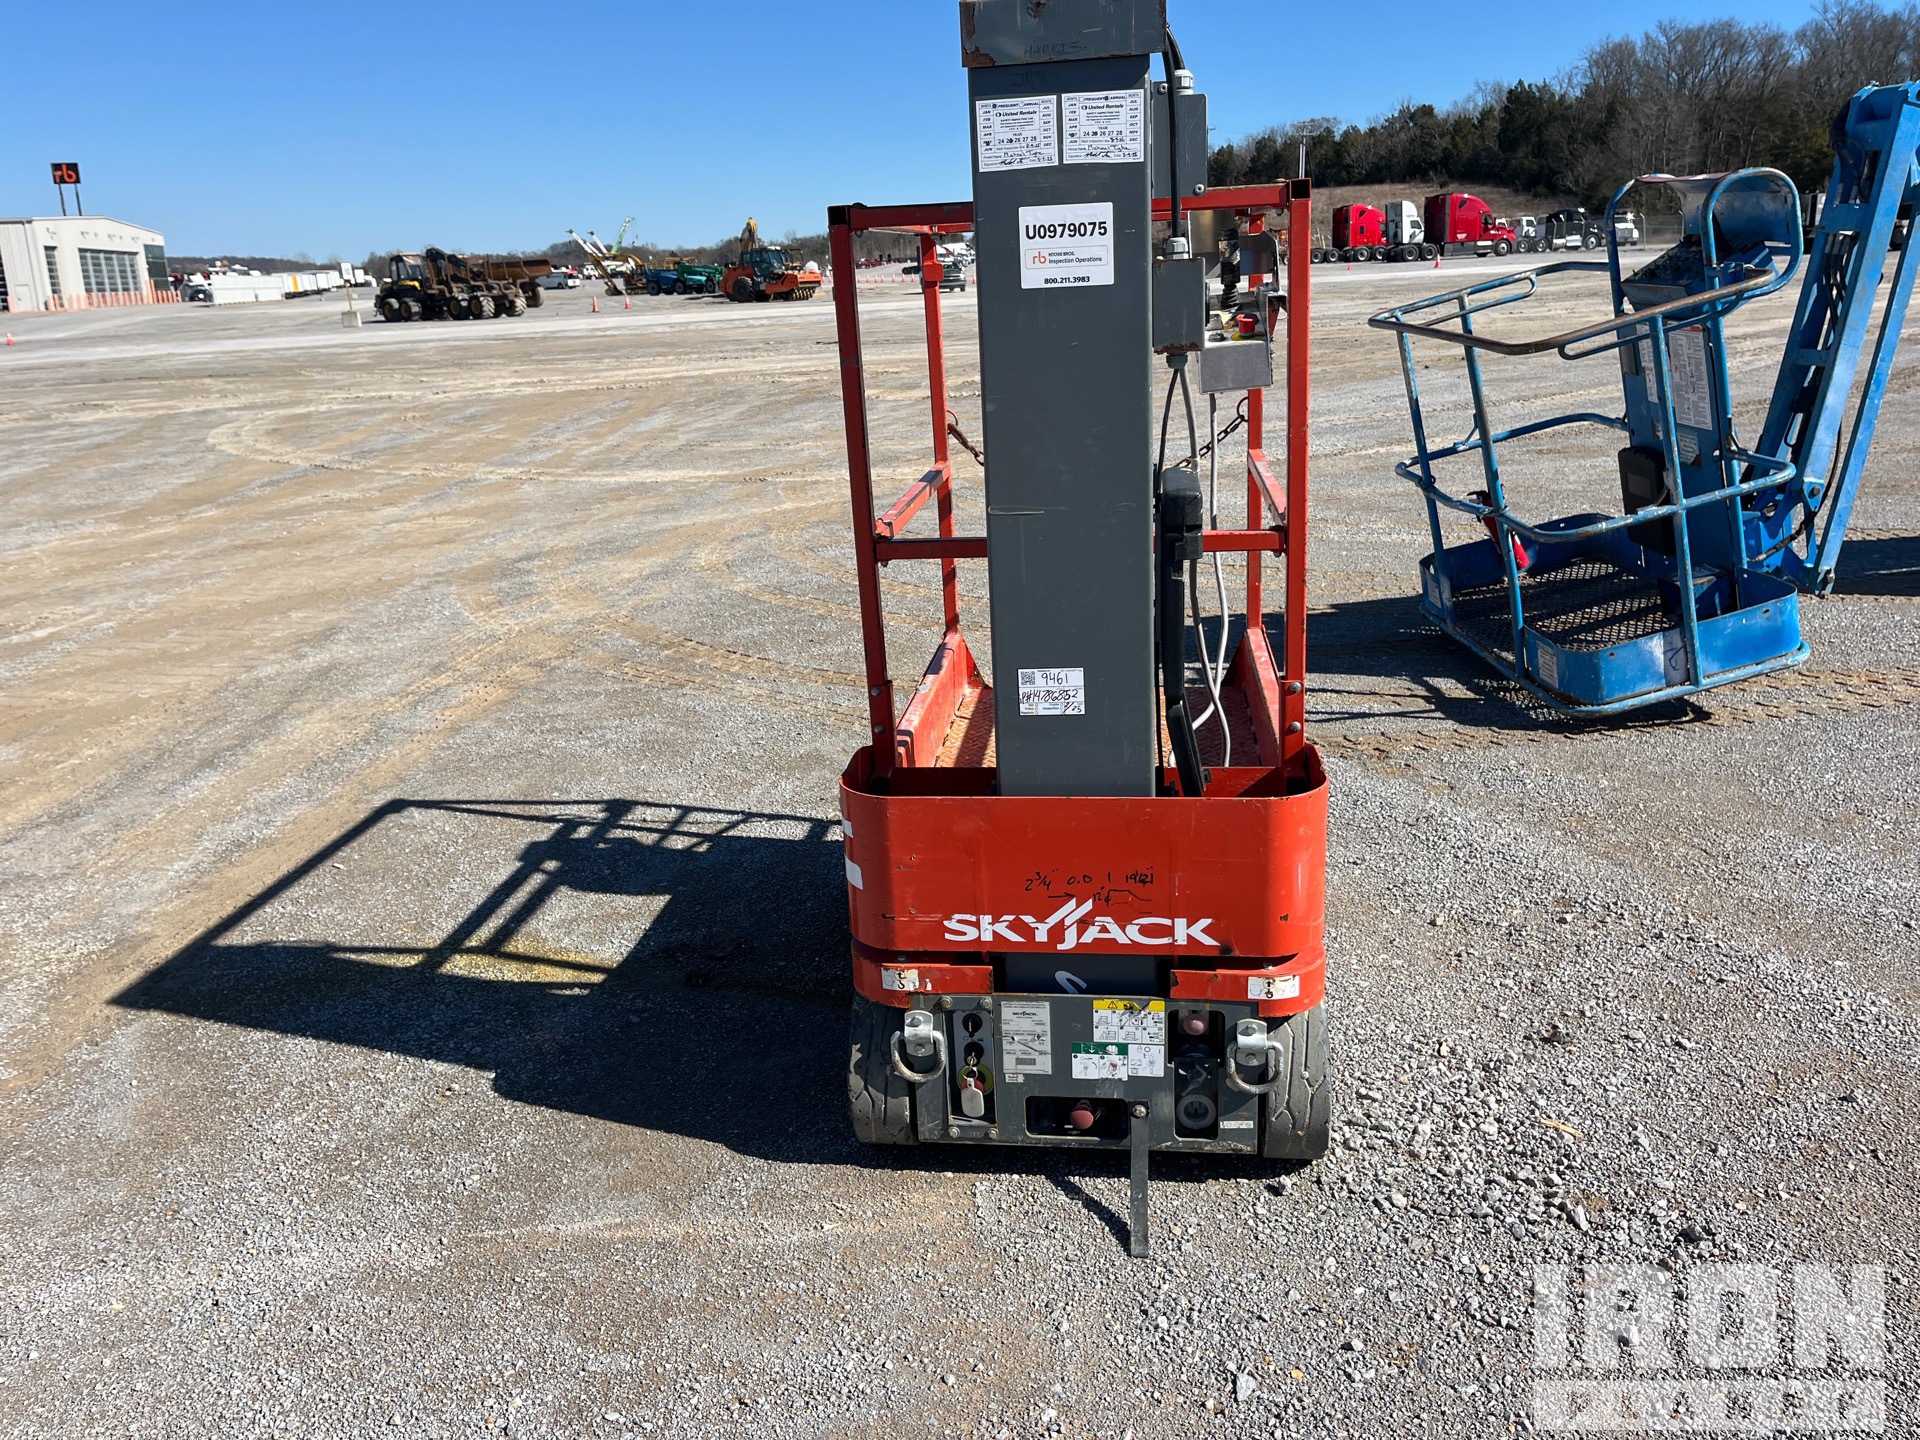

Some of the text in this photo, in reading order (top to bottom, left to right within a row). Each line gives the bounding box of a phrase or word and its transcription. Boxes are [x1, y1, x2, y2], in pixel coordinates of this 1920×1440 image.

[1026, 221, 1107, 239] U0979075
[1033, 251, 1046, 264] rb
[1044, 276, 1090, 284] 800.211.3983
[1041, 672, 1068, 685] 9461
[943, 897, 1221, 950] SKYJACK
